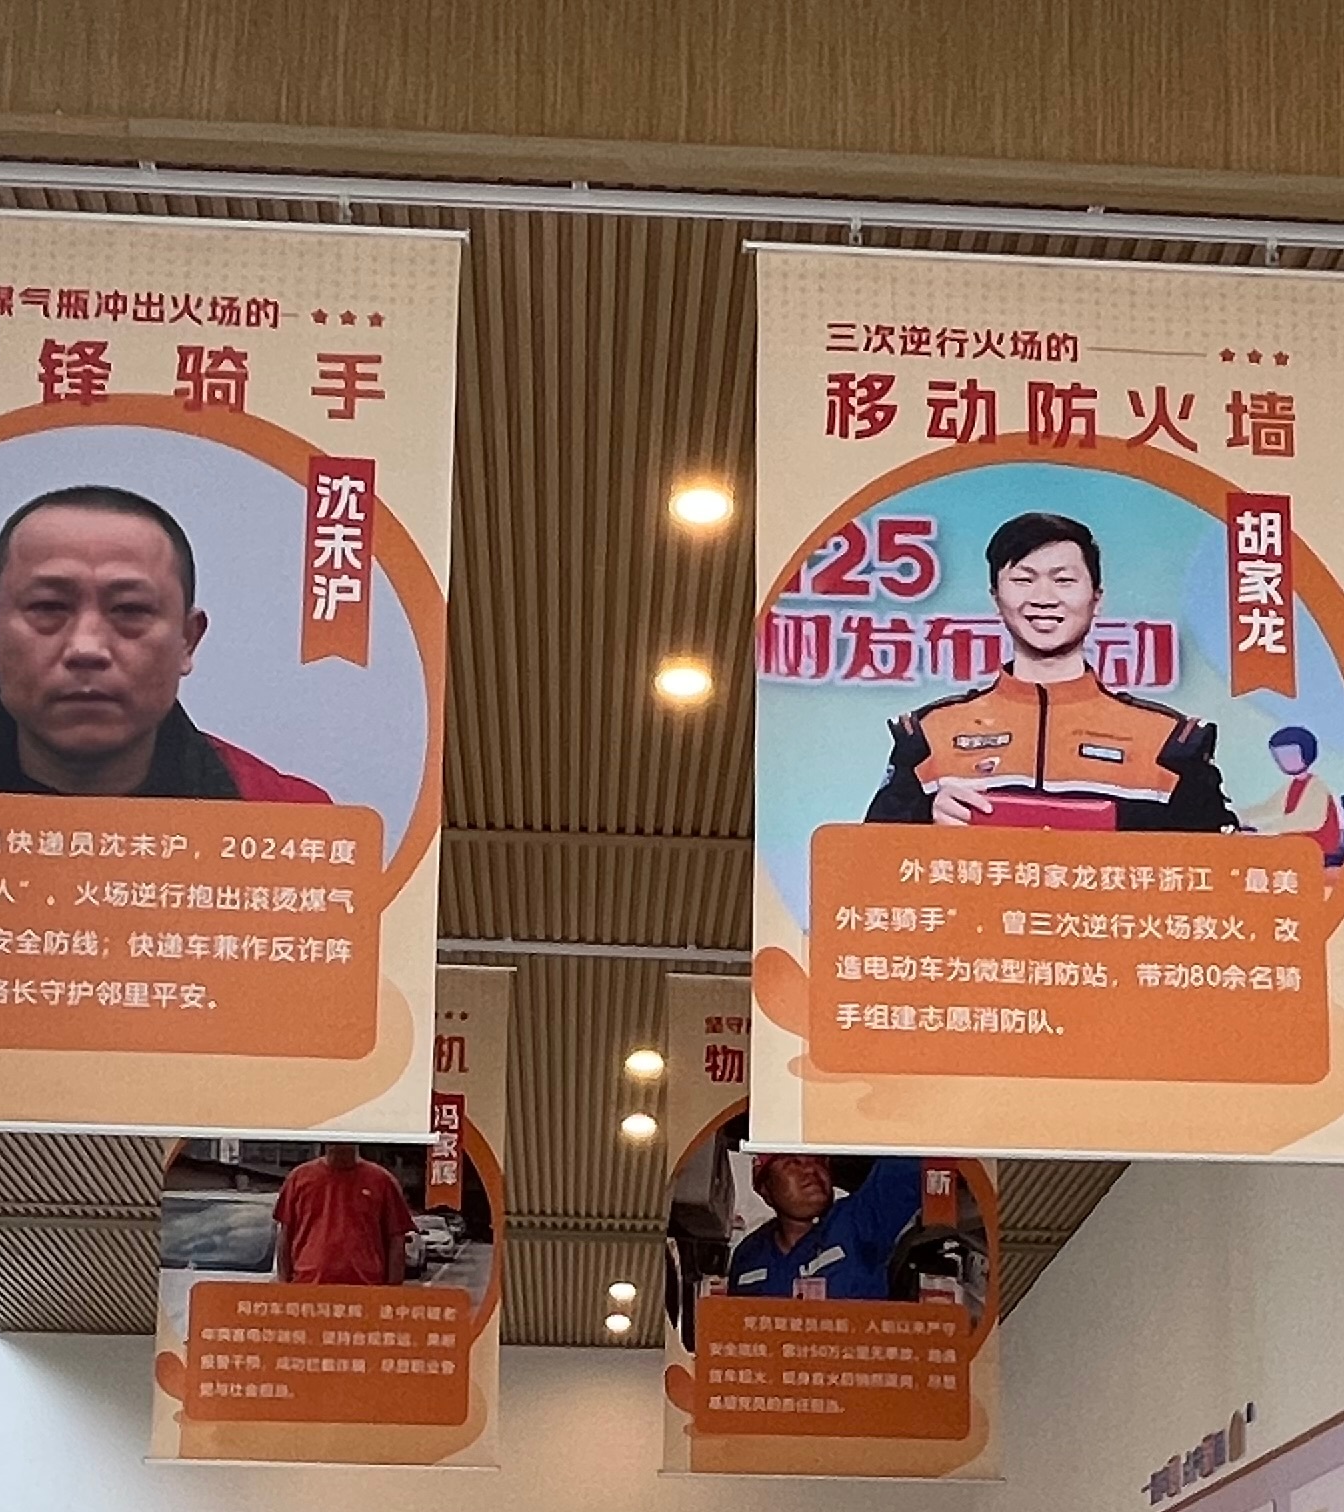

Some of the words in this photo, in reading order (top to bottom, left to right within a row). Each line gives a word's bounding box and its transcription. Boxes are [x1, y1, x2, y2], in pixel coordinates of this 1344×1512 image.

[825, 322, 1079, 362] 三次逆行火场的
[825, 372, 1296, 458] 移动防火墙
[1236, 512, 1288, 654] 胡家龙
[705, 1044, 743, 1083] 物
